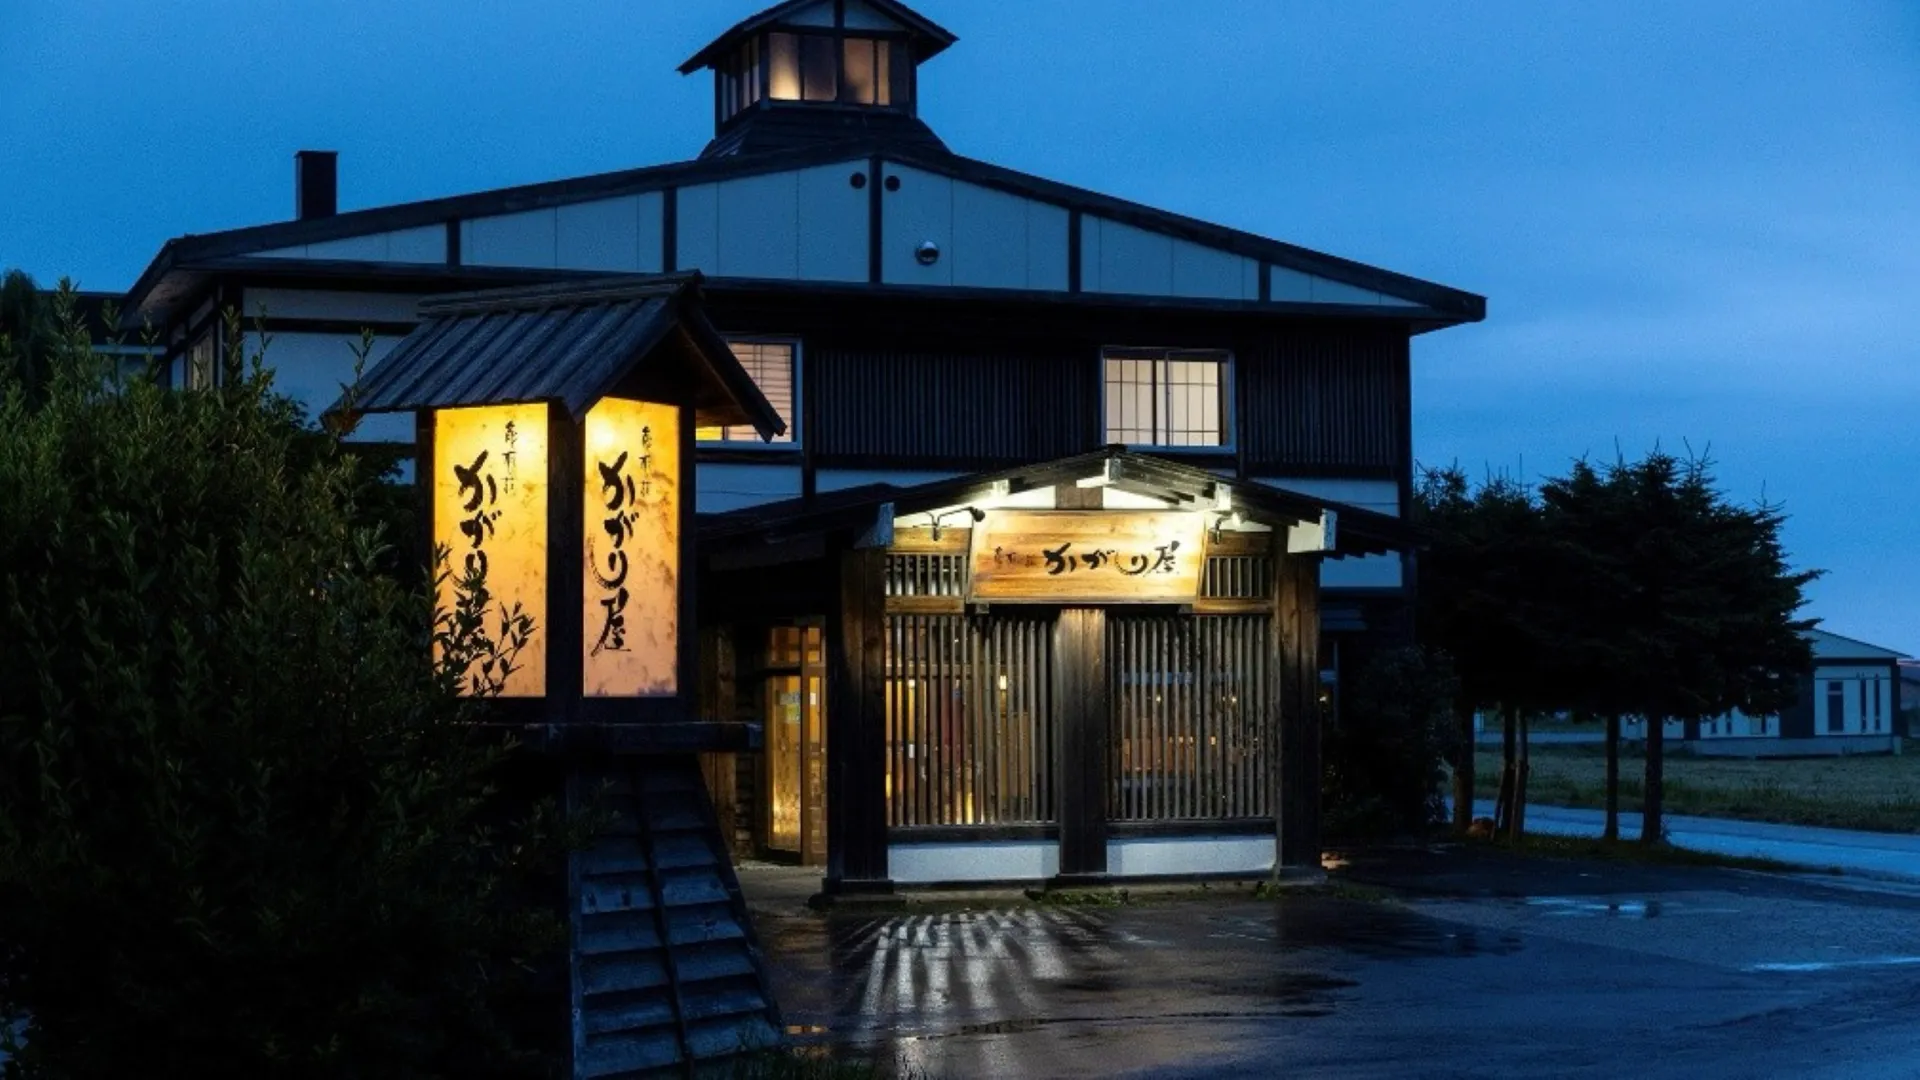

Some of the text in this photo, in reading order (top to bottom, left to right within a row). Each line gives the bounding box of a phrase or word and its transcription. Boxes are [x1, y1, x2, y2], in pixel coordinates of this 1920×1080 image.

[587, 451, 639, 657] かがり屋
[1043, 541, 1180, 576] かがり屋
